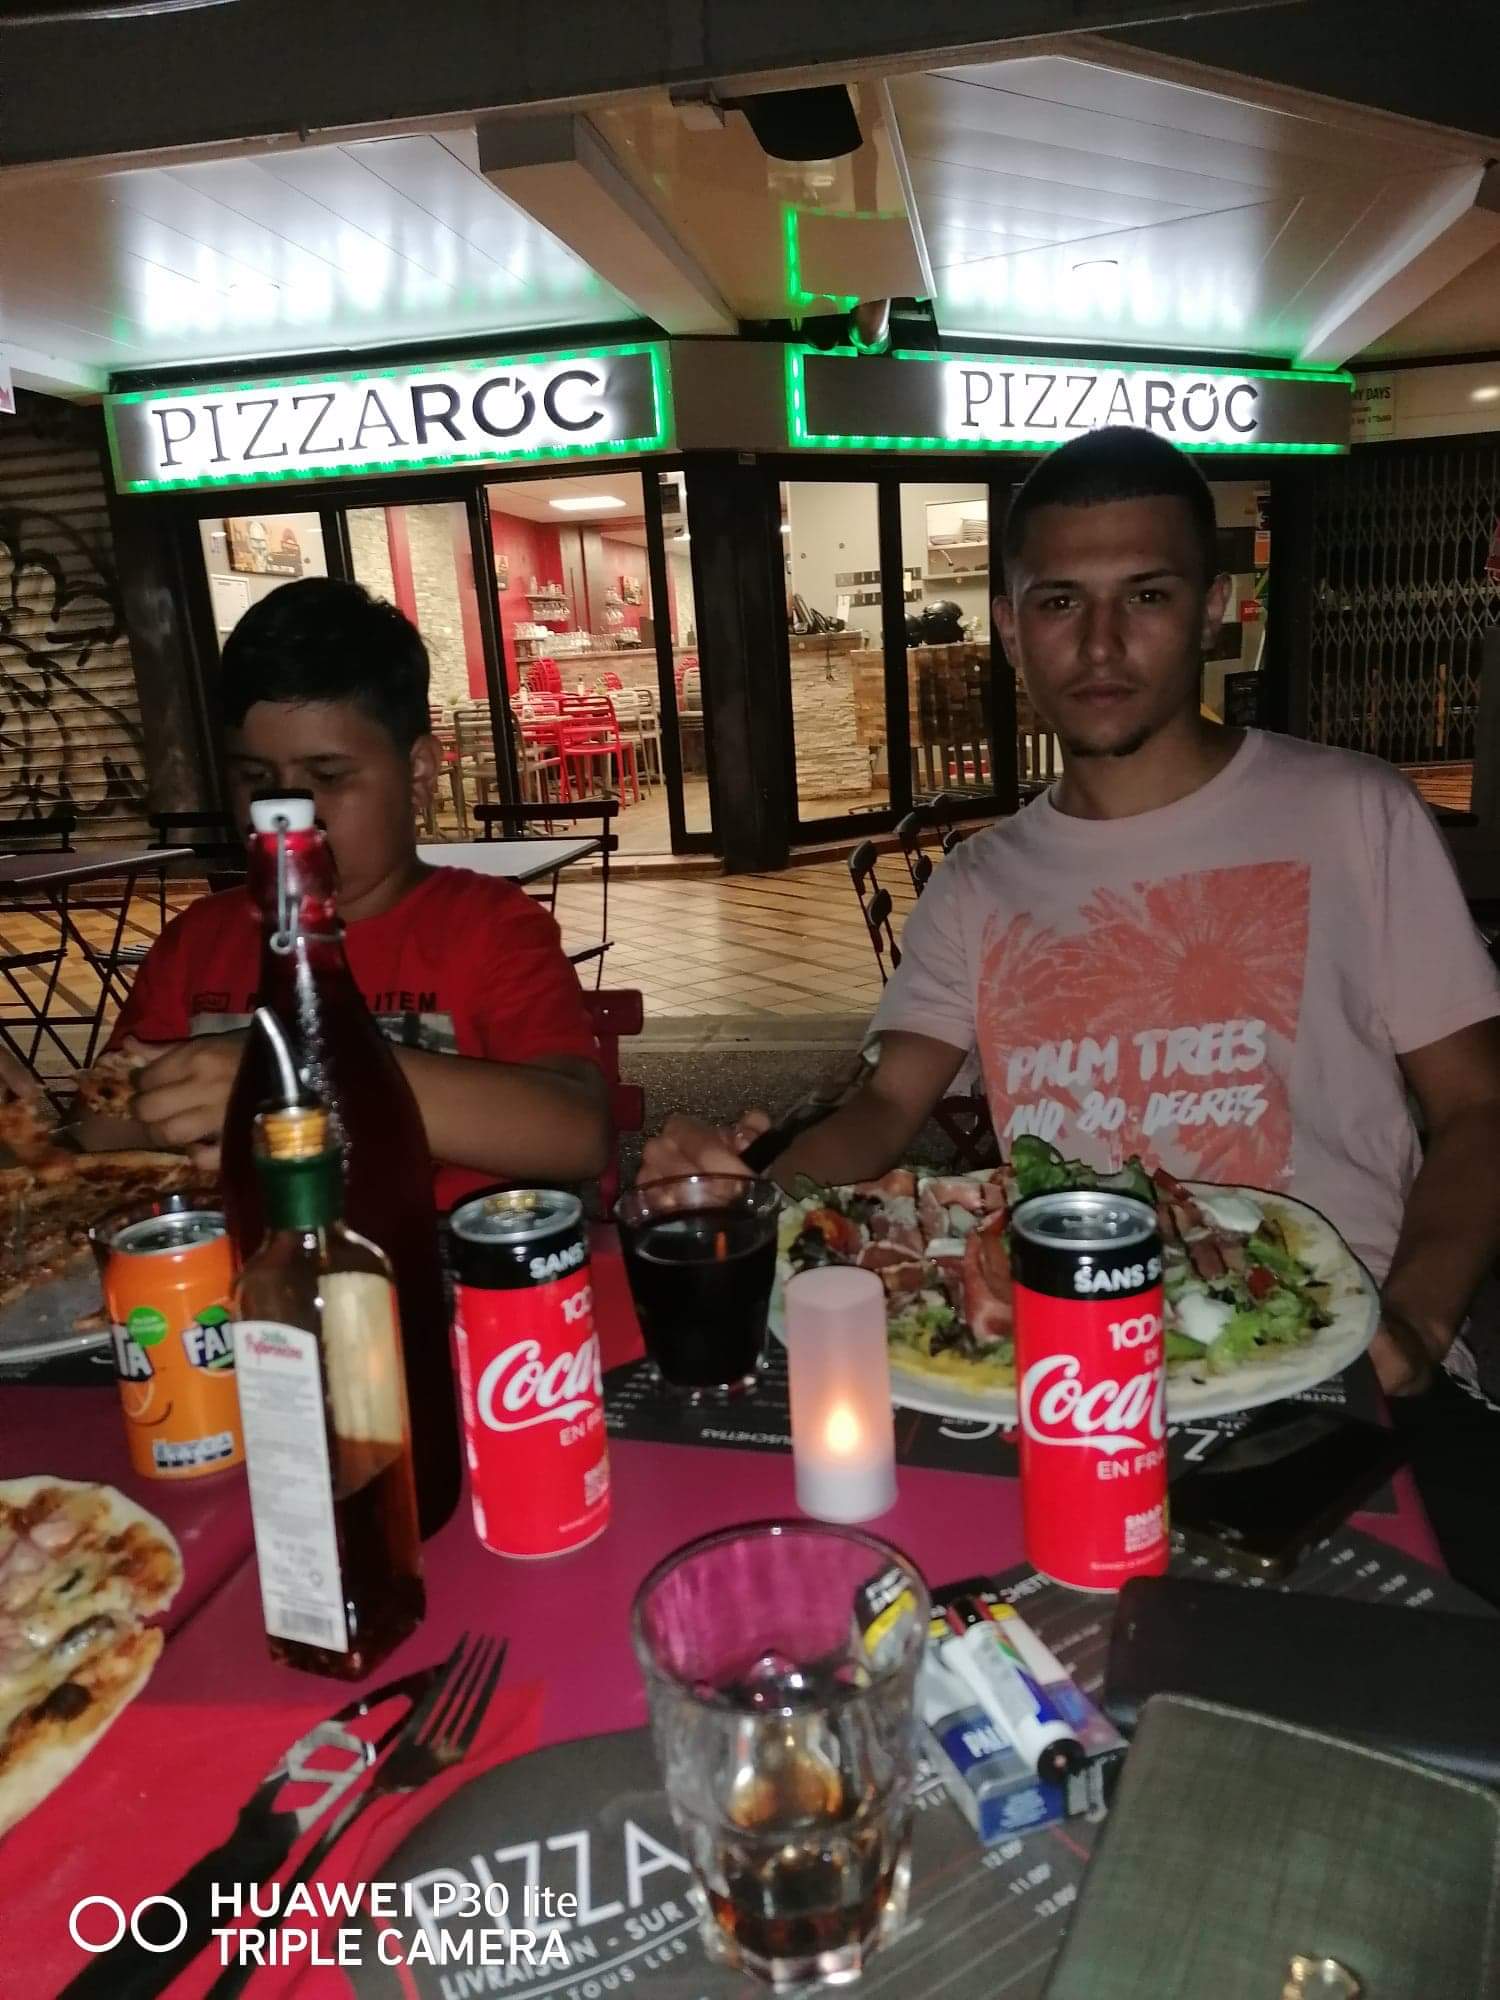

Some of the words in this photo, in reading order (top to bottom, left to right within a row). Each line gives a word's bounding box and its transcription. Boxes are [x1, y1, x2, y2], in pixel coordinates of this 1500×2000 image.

[1006, 1035, 1119, 1095] PALM
[1132, 1018, 1266, 1081] TREES
[1141, 1084, 1268, 1136] DEGREES
[1074, 1263, 1145, 1294] SANS
[1097, 1460, 1130, 1481] EN
[402, 1819, 693, 1966] PIZZA
[439, 1935, 600, 2000] LIVRAISON
[624, 1901, 685, 1941] SUR
